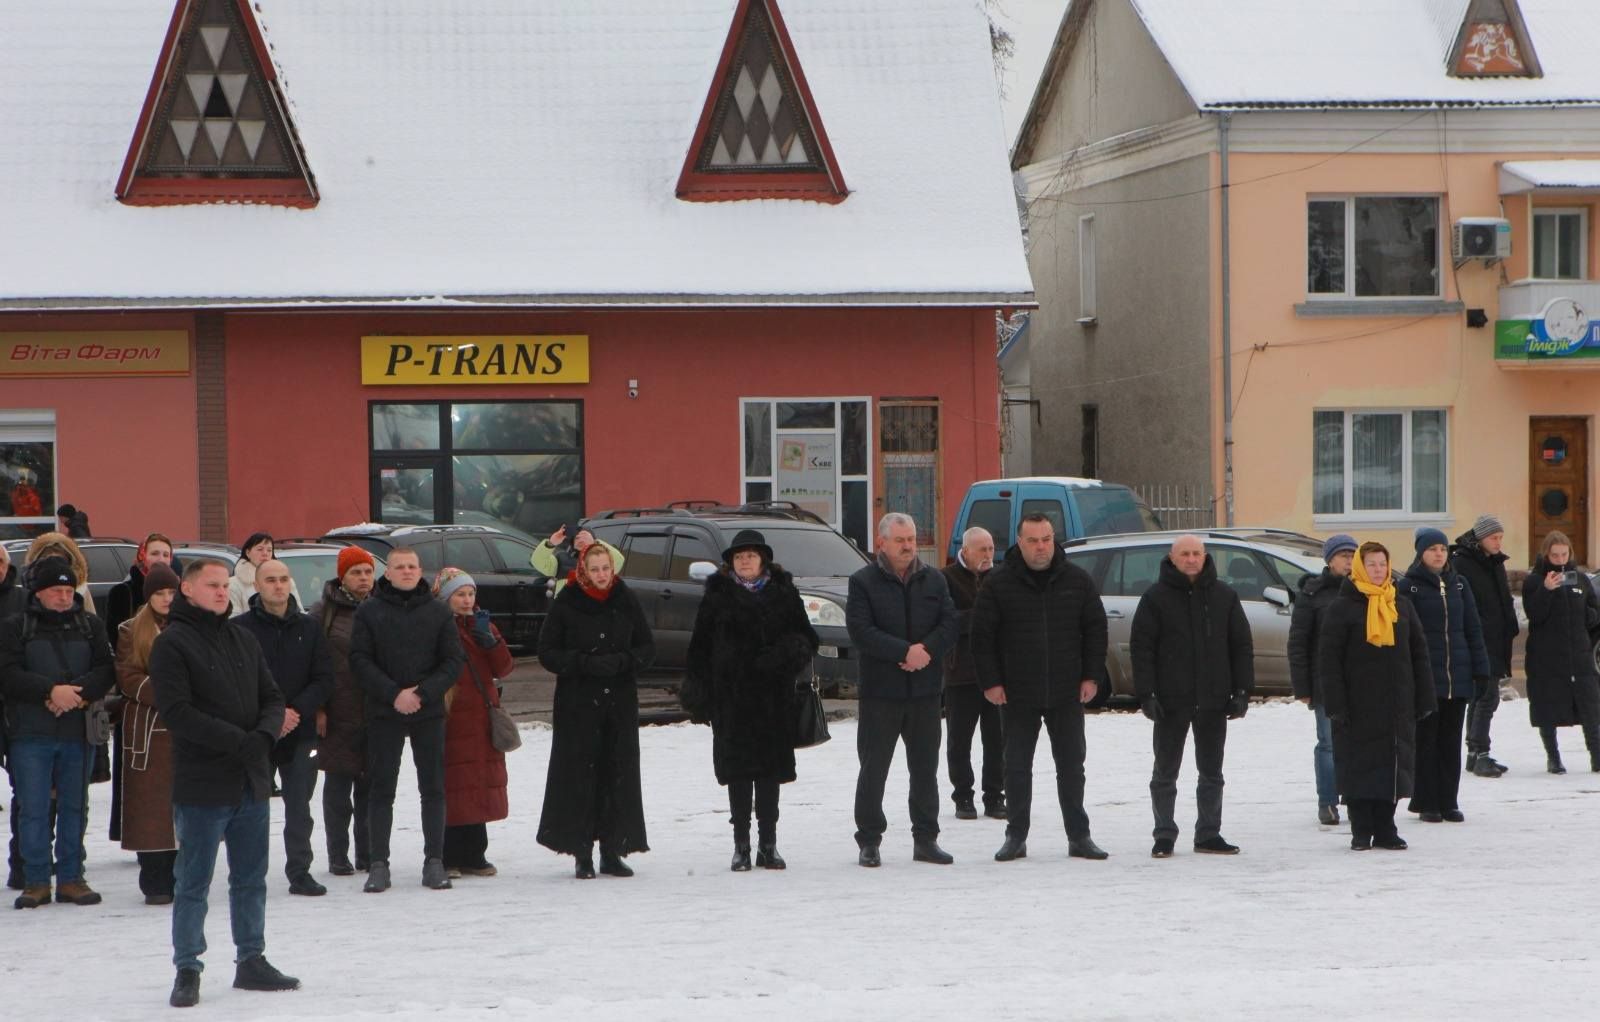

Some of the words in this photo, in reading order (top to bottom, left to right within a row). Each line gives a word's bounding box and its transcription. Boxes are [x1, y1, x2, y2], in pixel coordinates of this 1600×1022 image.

[11, 345, 71, 360] Віта
[77, 344, 161, 363] Фарм
[385, 343, 565, 376] P-TRANS
